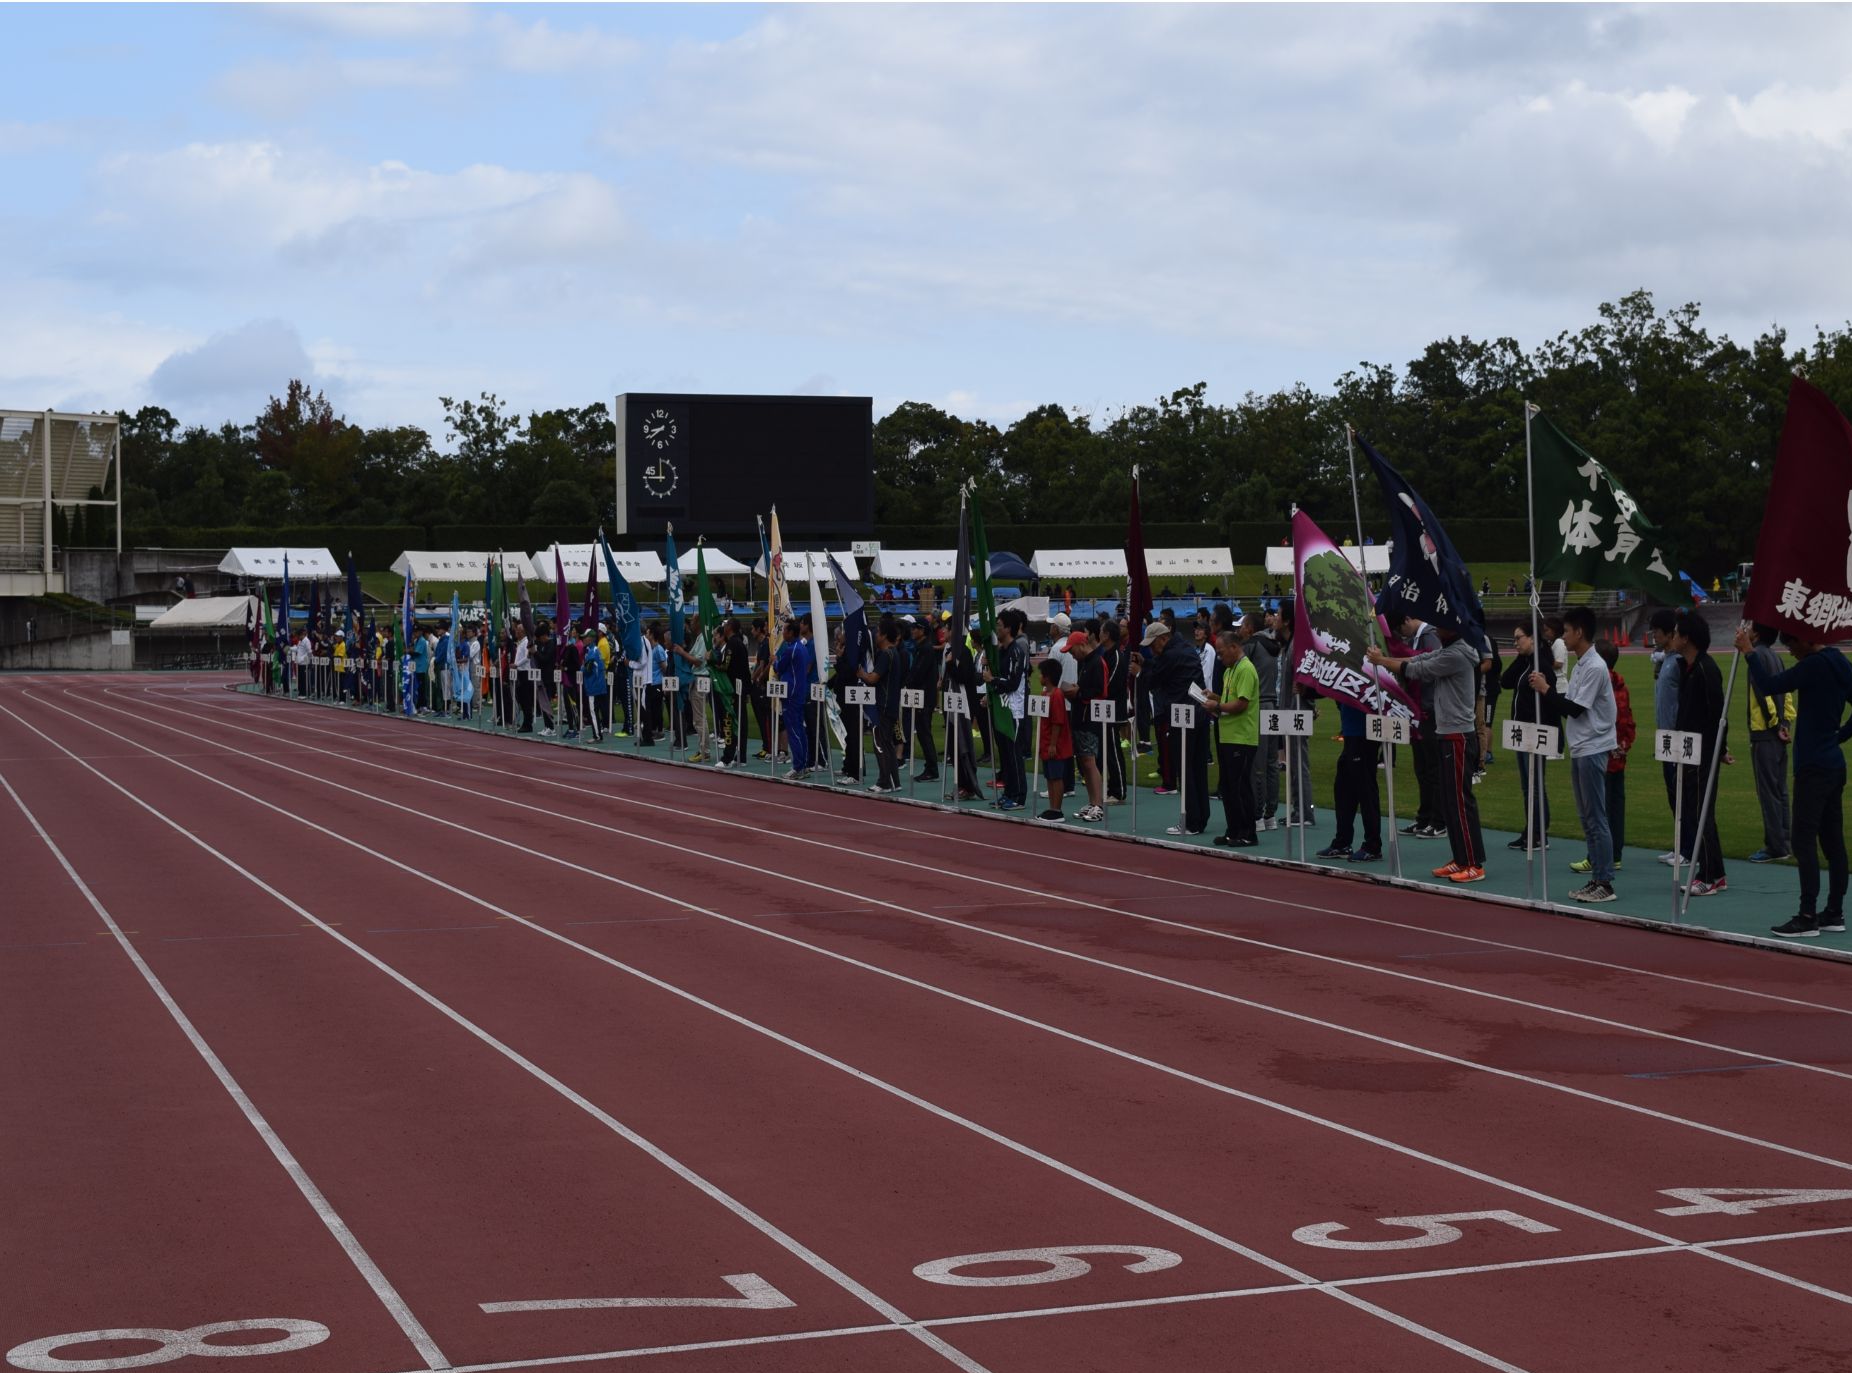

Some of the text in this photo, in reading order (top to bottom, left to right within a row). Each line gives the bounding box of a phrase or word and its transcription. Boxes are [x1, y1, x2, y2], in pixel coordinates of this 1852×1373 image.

[656, 409, 664, 418] 12
[643, 424, 649, 434] 9
[671, 425, 677, 434] 3
[657, 440, 663, 449] 6
[645, 466, 655, 476] 45
[1268, 713, 1304, 732] 逢坂
[1372, 718, 1402, 741] 明治
[1510, 724, 1549, 750] 神戸
[1662, 734, 1694, 760] 東郷
[1292, 1210, 1562, 1252] 5
[912, 1245, 1183, 1287] 6
[478, 1273, 798, 1313] 7
[6, 1318, 330, 1373] 8
